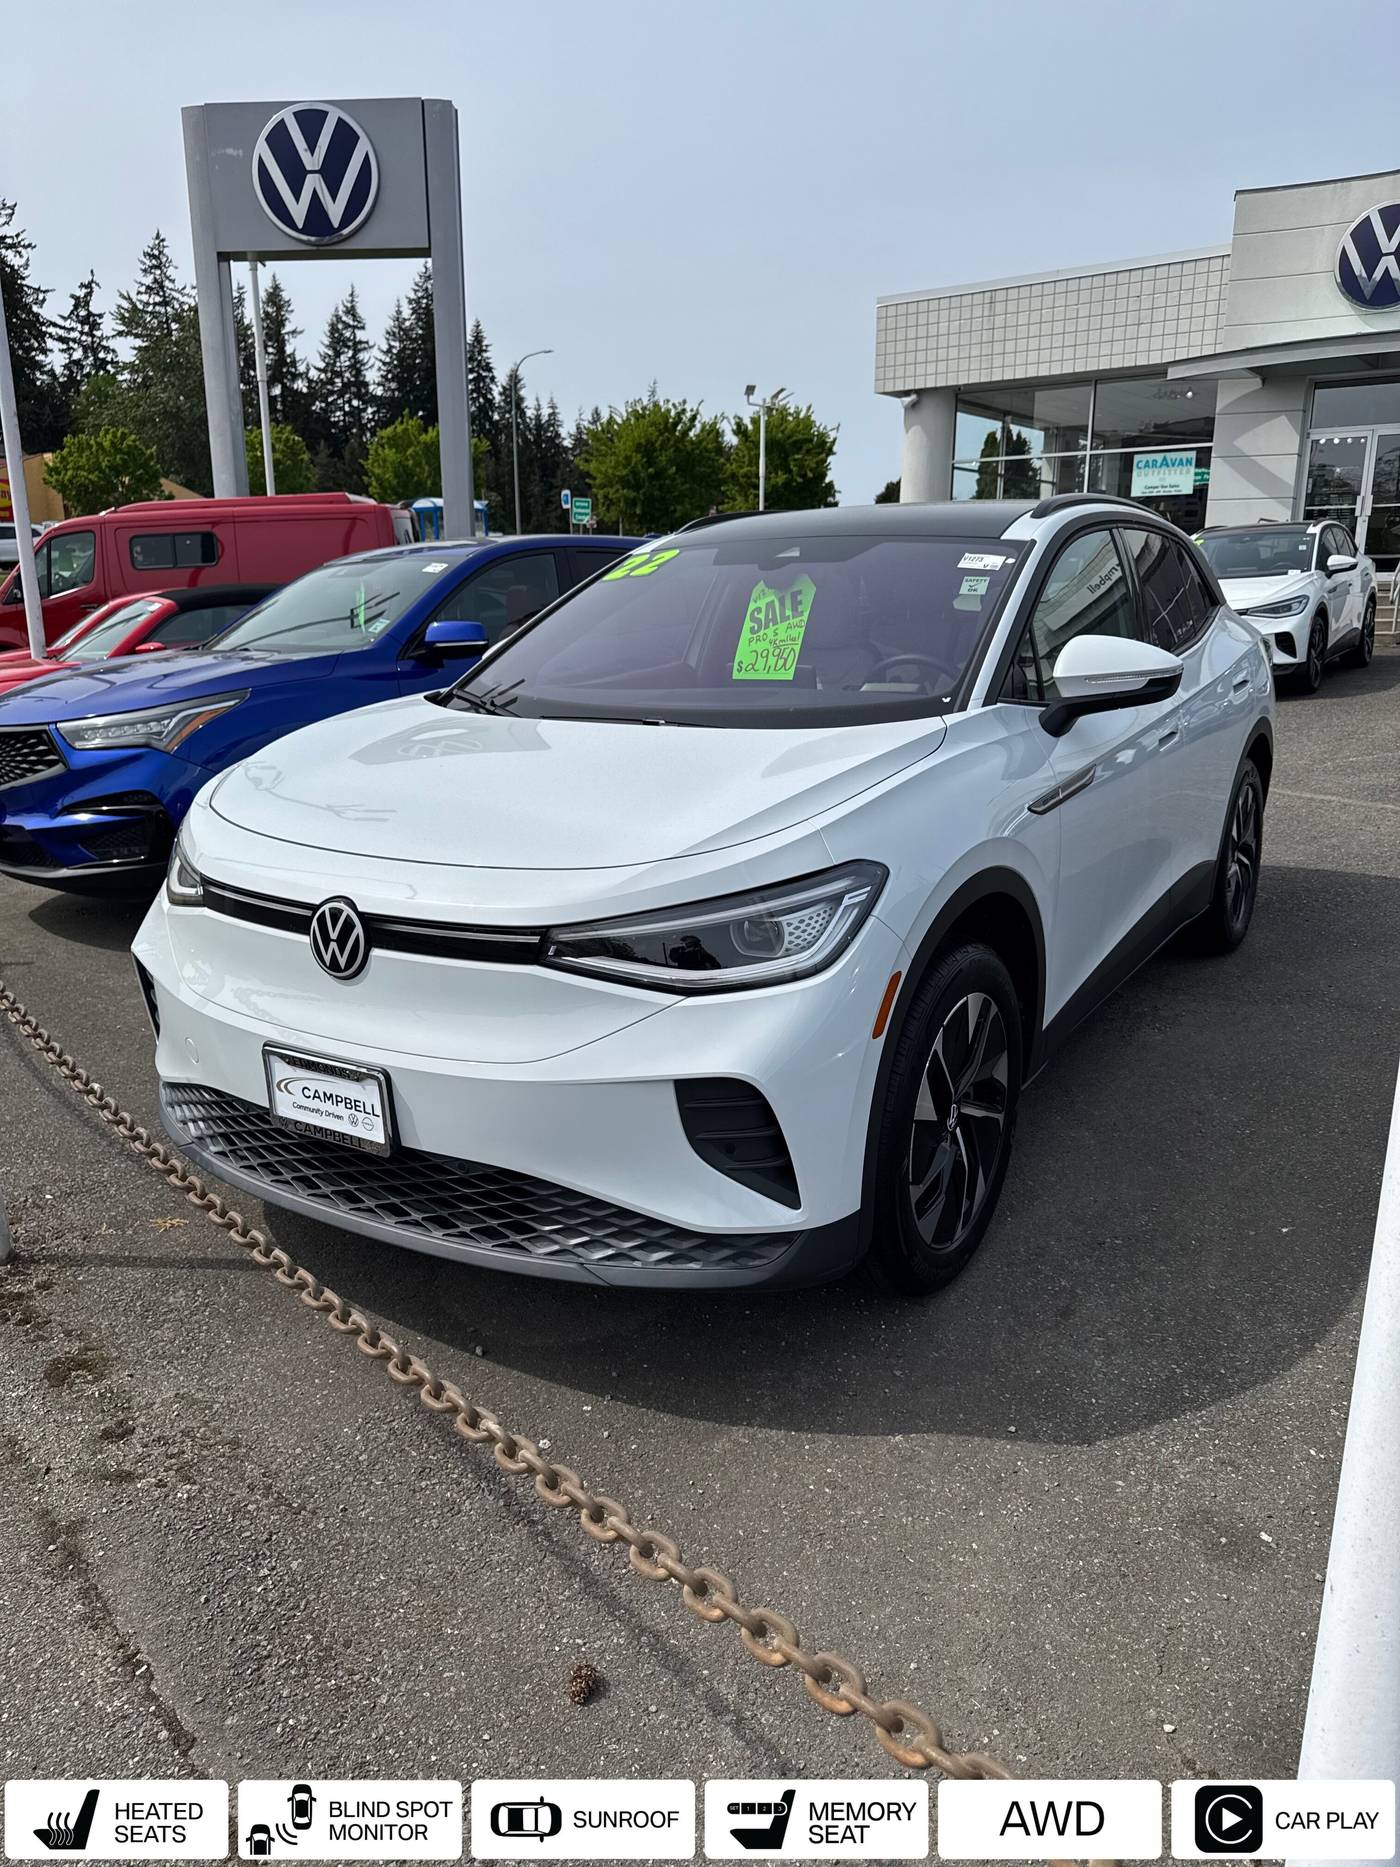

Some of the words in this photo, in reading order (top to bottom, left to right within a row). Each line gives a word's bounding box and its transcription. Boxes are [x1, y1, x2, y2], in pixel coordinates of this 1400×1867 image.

[254, 104, 376, 240] VW
[1136, 455, 1193, 470] CARAVAN
[602, 548, 680, 581] 22
[749, 589, 804, 635] SALE
[311, 904, 363, 974] VW
[292, 1101, 325, 1117] Community
[324, 1109, 344, 1121] Driven
[301, 1086, 380, 1118] CAMPBELL
[294, 1121, 366, 1149] CAMPBELL
